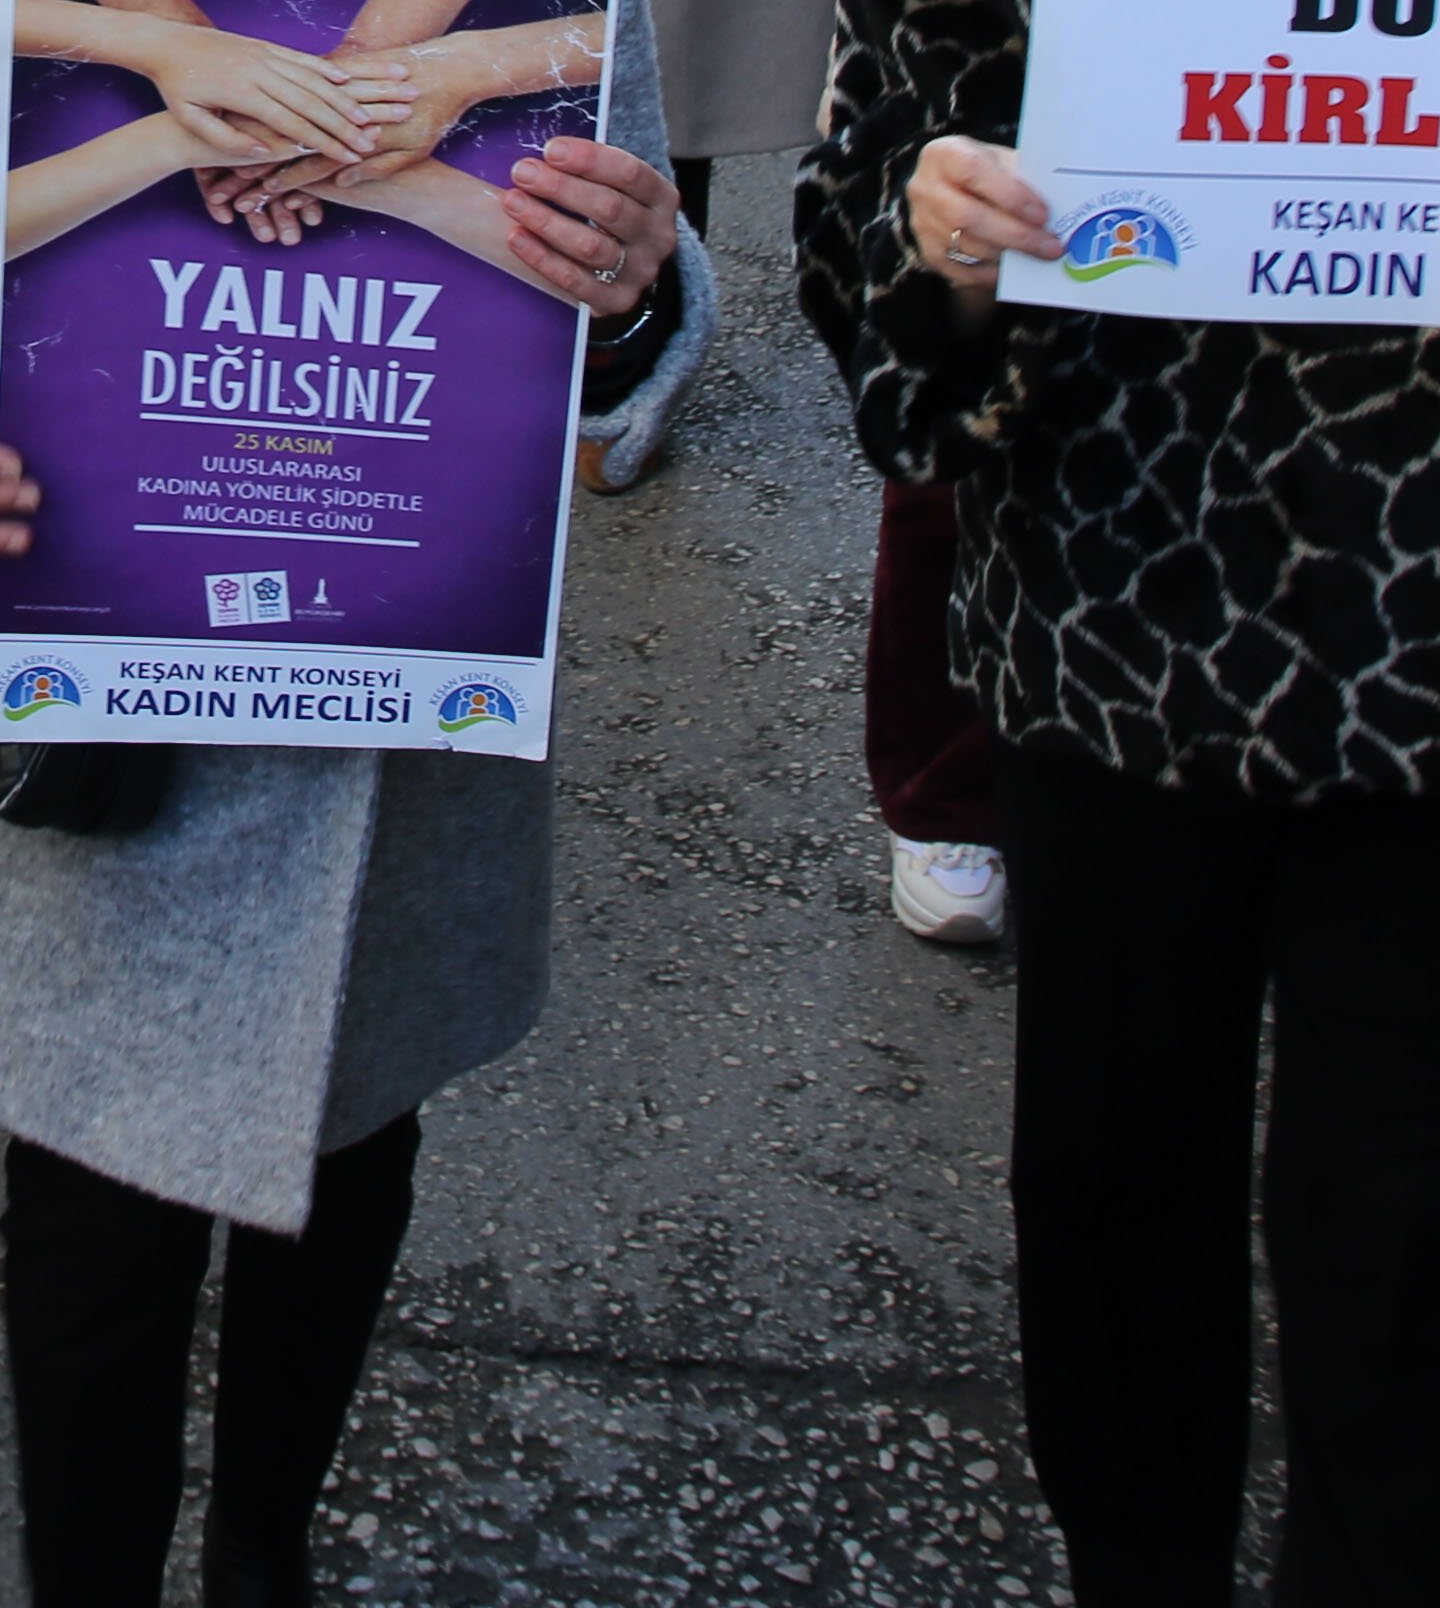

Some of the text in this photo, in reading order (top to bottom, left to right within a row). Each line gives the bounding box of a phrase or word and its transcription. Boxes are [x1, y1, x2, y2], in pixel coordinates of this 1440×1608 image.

[1271, 199, 1386, 240] KEŞAN
[1247, 248, 1427, 301] KADIN
[147, 257, 444, 352] YALNIZ
[138, 343, 438, 427] DEĞİLSİNİZ
[233, 432, 334, 456] 25 KASIM
[201, 455, 362, 483] ULUSLARARASI
[137, 476, 424, 513] KADINA YÖNELİK ŞİDDETLE
[182, 502, 375, 533] MÜCADELE GÜNÜ
[22, 653, 55, 667] KENT
[119, 660, 402, 690] KEŞAN KENT KONSEYİ
[458, 671, 491, 684] KENT
[104, 688, 412, 724] KADIN MECLİSİ
